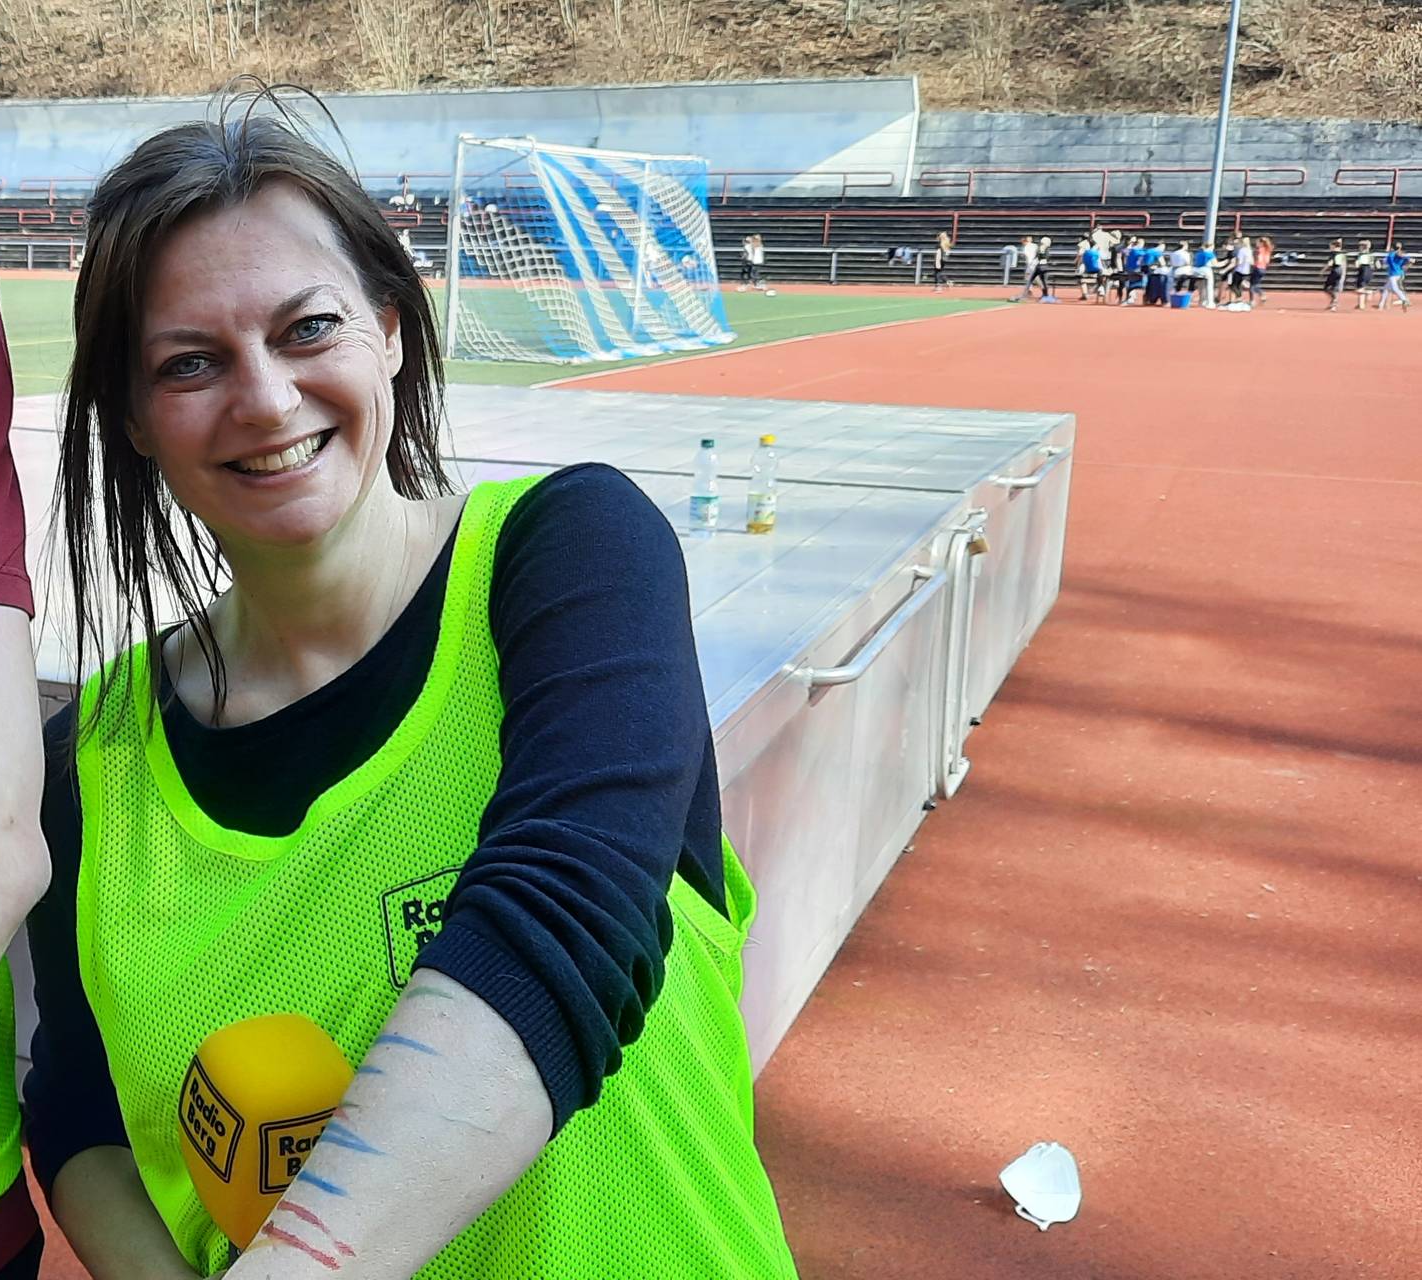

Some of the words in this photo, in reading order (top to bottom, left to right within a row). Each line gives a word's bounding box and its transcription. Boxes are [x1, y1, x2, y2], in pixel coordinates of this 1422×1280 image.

[402, 898, 444, 931] Ra
[187, 1101, 217, 1157] Berg
[189, 1077, 226, 1137] Radio
